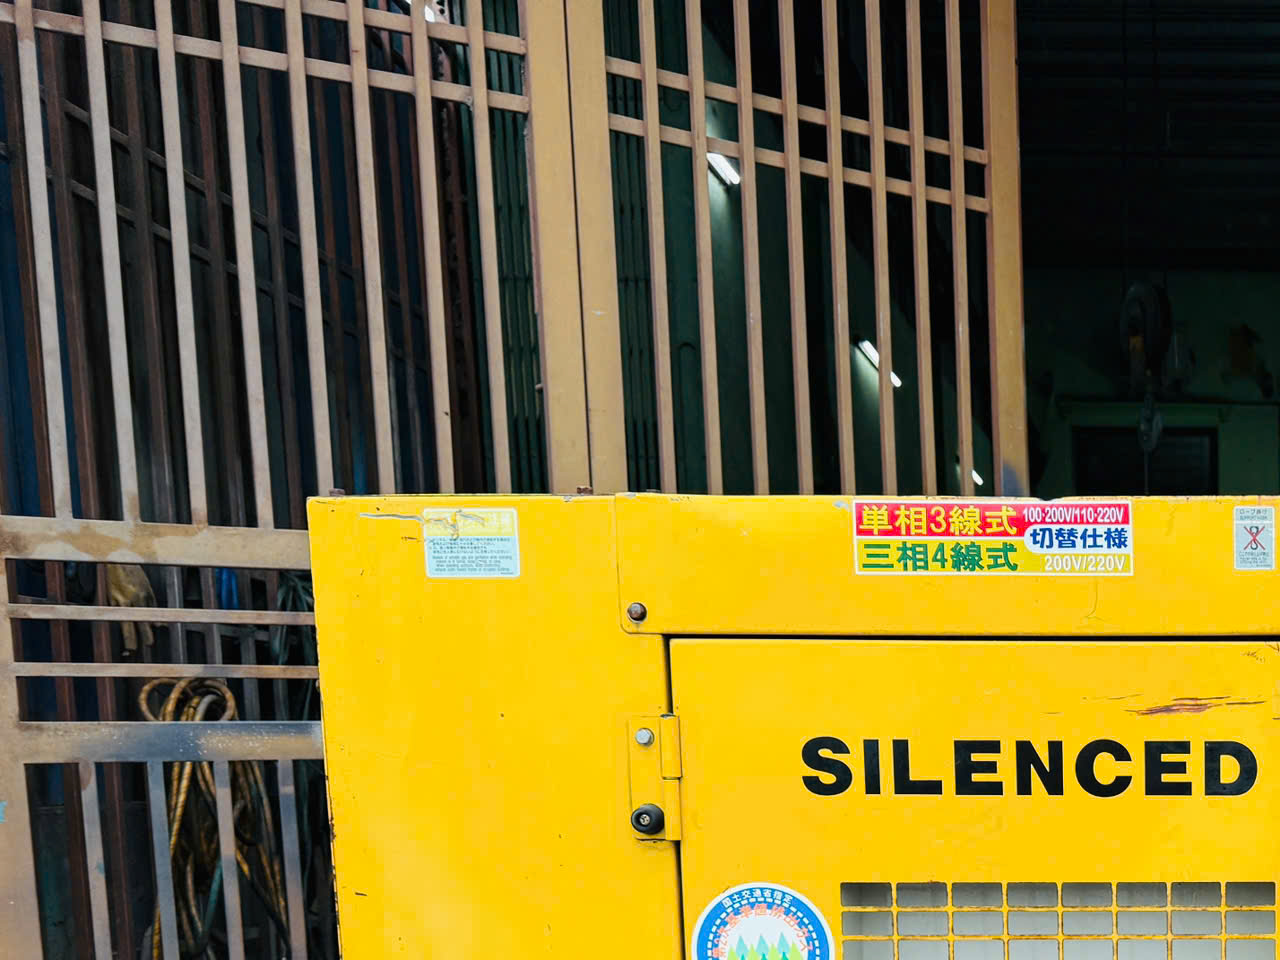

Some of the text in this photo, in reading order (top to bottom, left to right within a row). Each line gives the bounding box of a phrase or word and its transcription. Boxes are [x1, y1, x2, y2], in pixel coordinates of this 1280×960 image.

[859, 505, 1018, 536] 単相3線式
[1030, 527, 1128, 549] 切替仕様
[862, 541, 1019, 572] 三相4線式
[1044, 555, 1125, 571] 200V/220V
[801, 736, 1259, 798] SILENCED
